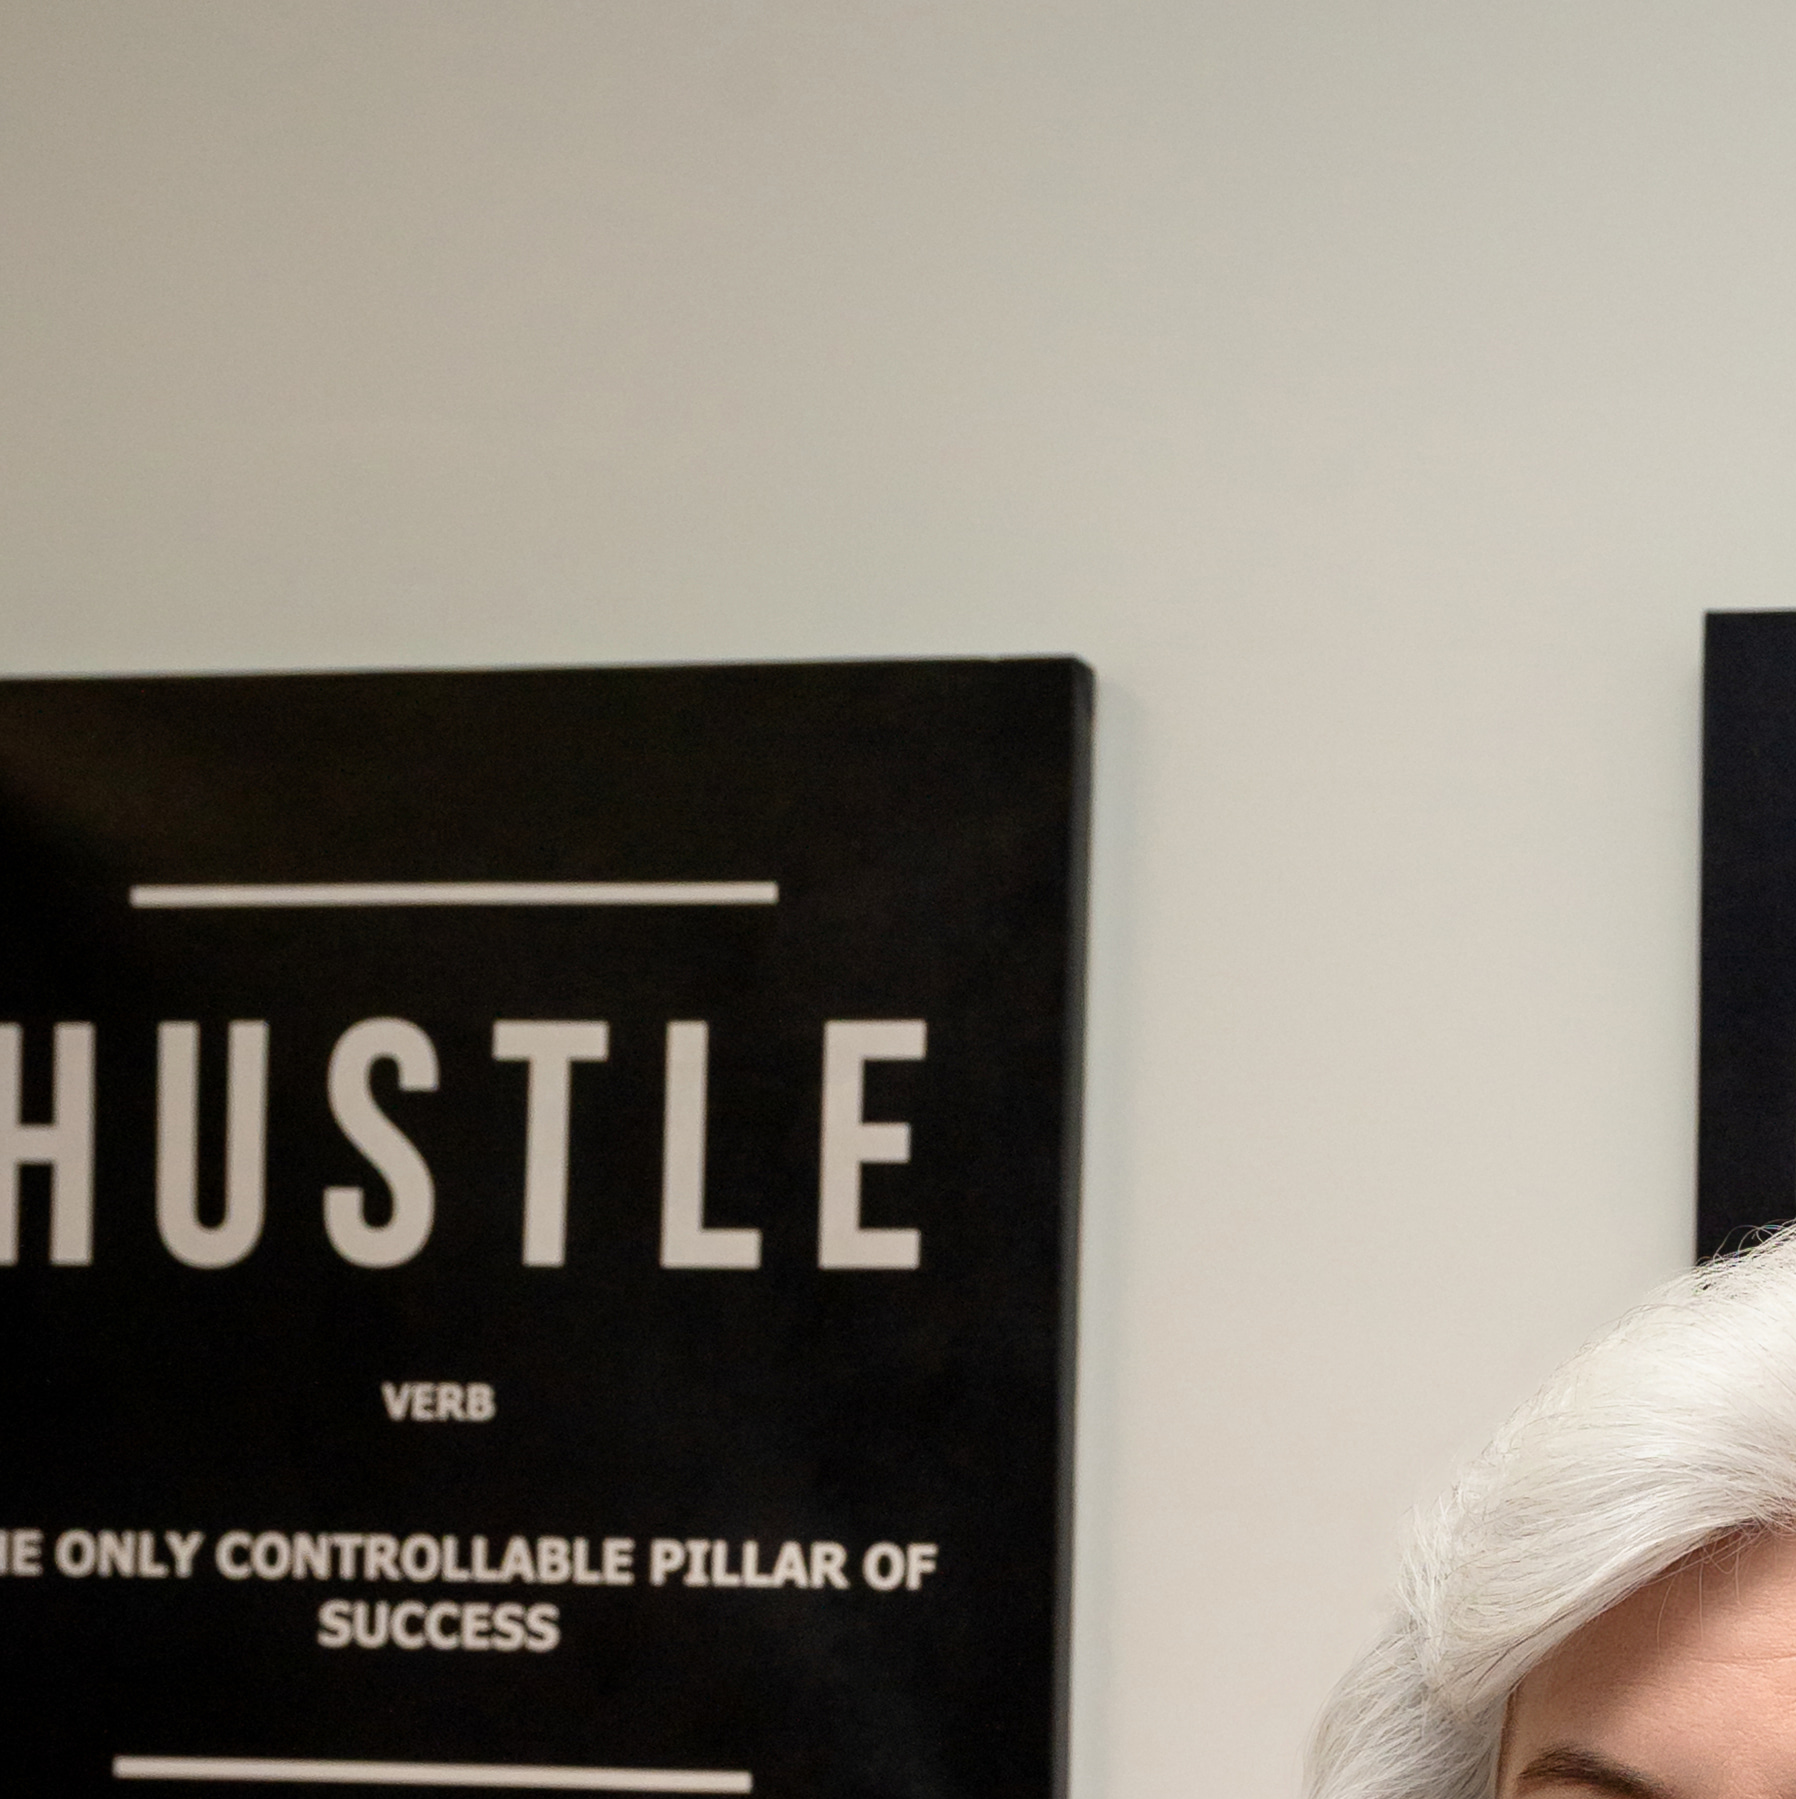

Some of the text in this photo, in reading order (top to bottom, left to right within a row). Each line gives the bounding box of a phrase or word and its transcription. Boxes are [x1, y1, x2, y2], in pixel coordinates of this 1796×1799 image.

[0, 1016, 928, 1270] HUSTLE
[382, 1381, 496, 1422] VERB
[55, 1528, 204, 1579] ONLY
[214, 1529, 635, 1586] CONTROLLABLE
[649, 1537, 850, 1590] PILLAR
[861, 1541, 939, 1592] OF
[317, 1599, 561, 1653] SUCCESS
